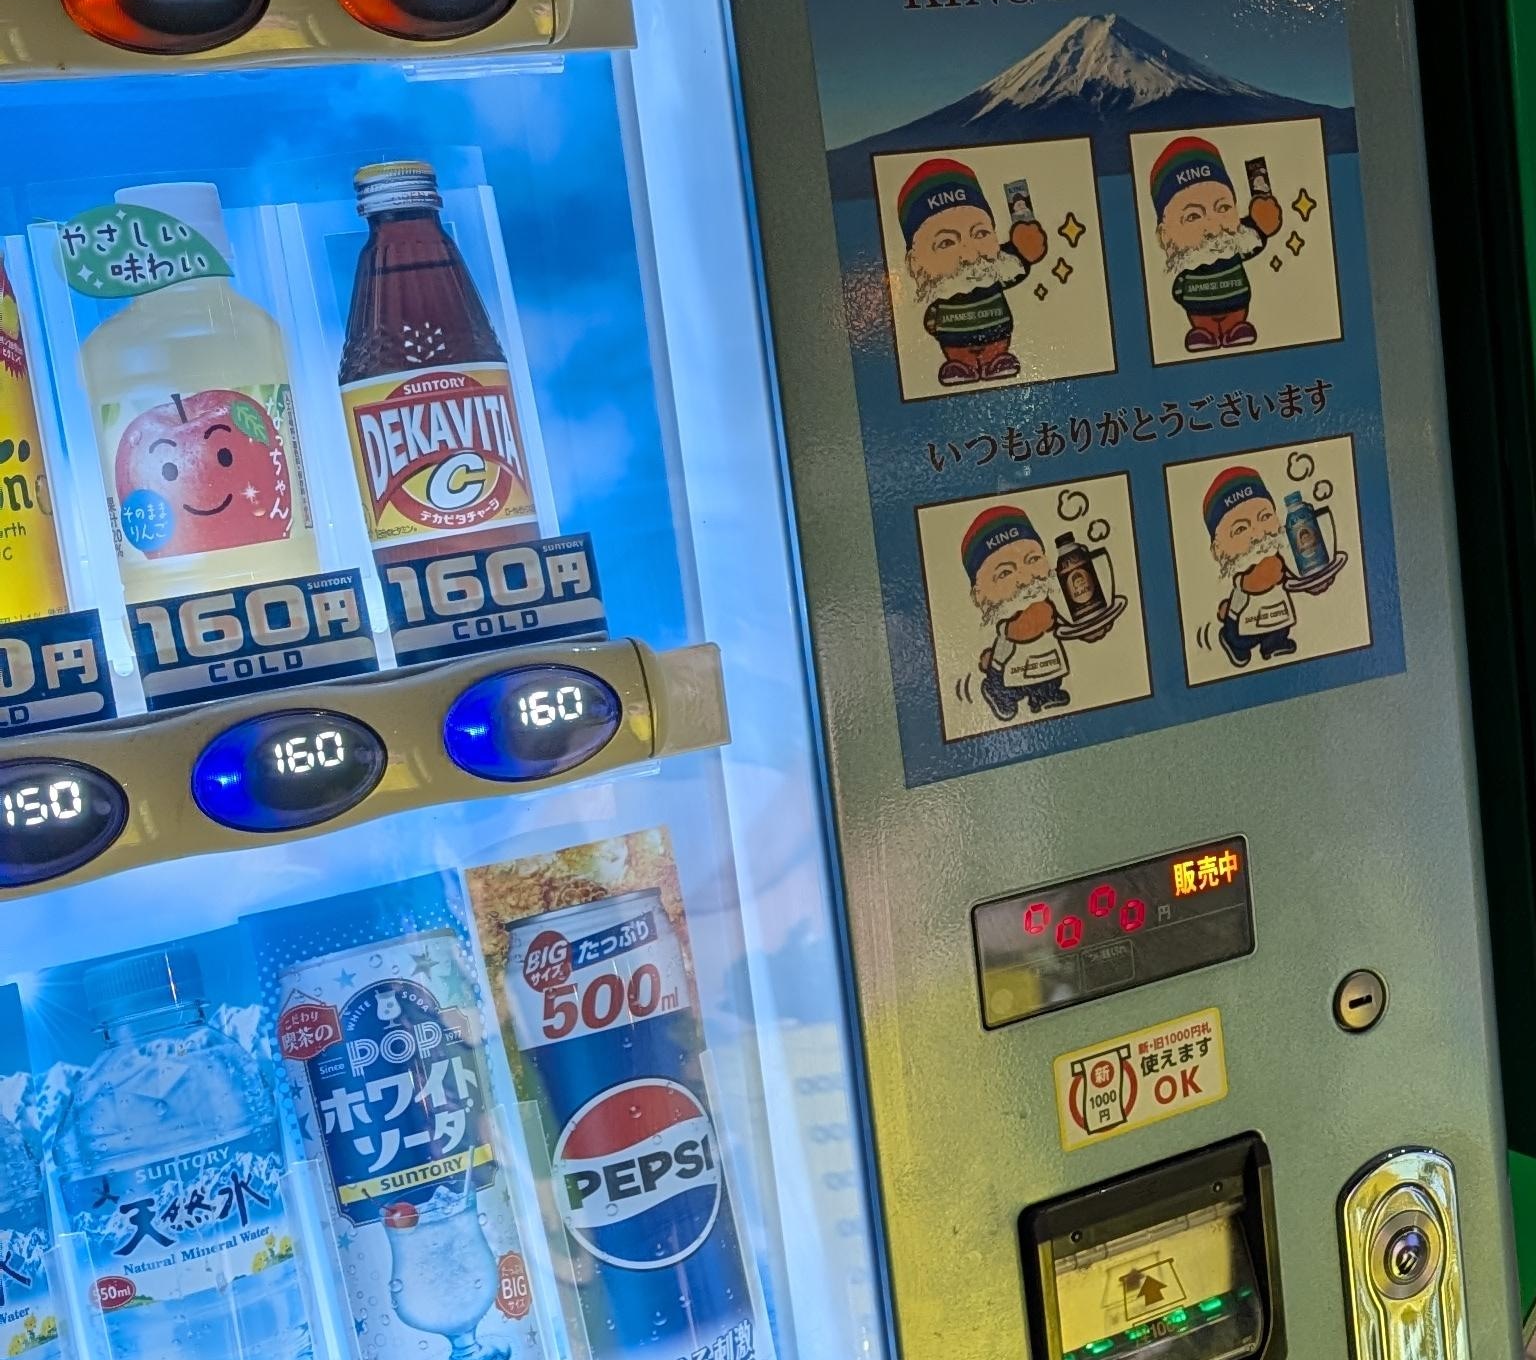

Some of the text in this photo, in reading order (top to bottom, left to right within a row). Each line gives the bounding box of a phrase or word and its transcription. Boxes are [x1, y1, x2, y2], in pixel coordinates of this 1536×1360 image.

[1175, 164, 1212, 185] KING
[926, 187, 967, 212] KING
[62, 223, 188, 256] やさしい
[110, 253, 206, 284] 味わい
[403, 376, 466, 395] SUNTORY
[925, 377, 1333, 473] いつもありがとうございます
[359, 394, 524, 510] DEKAVITA C
[123, 503, 168, 521] そのまま
[1222, 485, 1255, 507] KING
[129, 521, 168, 540] りんご
[542, 539, 584, 553] SUNTORY
[984, 526, 1021, 551] KING
[306, 574, 353, 591] SUNTORY
[387, 547, 592, 624] 160円
[137, 583, 361, 668] 160円
[452, 609, 539, 640] COLD
[208, 650, 303, 684] COLD
[518, 685, 584, 726] 160
[274, 730, 345, 776] 160
[1, 779, 81, 828] 150
[1173, 850, 1239, 896] 販売中
[526, 939, 568, 974] BIG
[577, 918, 650, 961] たっぷり
[530, 966, 566, 986] サイズ
[284, 1011, 320, 1029] こだわり
[346, 990, 430, 1032] WHITE SODA
[281, 1024, 334, 1053] 喫茶の
[346, 1020, 443, 1078] POP
[1137, 1022, 1212, 1056] 新・旧1000円札
[319, 1062, 345, 1076] Since
[1140, 1035, 1212, 1078] 使えます
[1094, 1062, 1112, 1086] 新
[1154, 1064, 1203, 1106] OK
[320, 1056, 479, 1133] ホワイト
[1089, 1090, 1118, 1110] 1000
[1099, 1108, 1111, 1122] 円
[353, 1097, 474, 1174] ソーダ
[134, 1147, 229, 1183] SUNTORY
[380, 1156, 464, 1192] SUNTORY
[564, 1133, 714, 1211] PEPSI
[114, 1171, 270, 1256] 天然水
[123, 1225, 270, 1275] Natural Mineral Water
[501, 1276, 527, 1299] BIG
